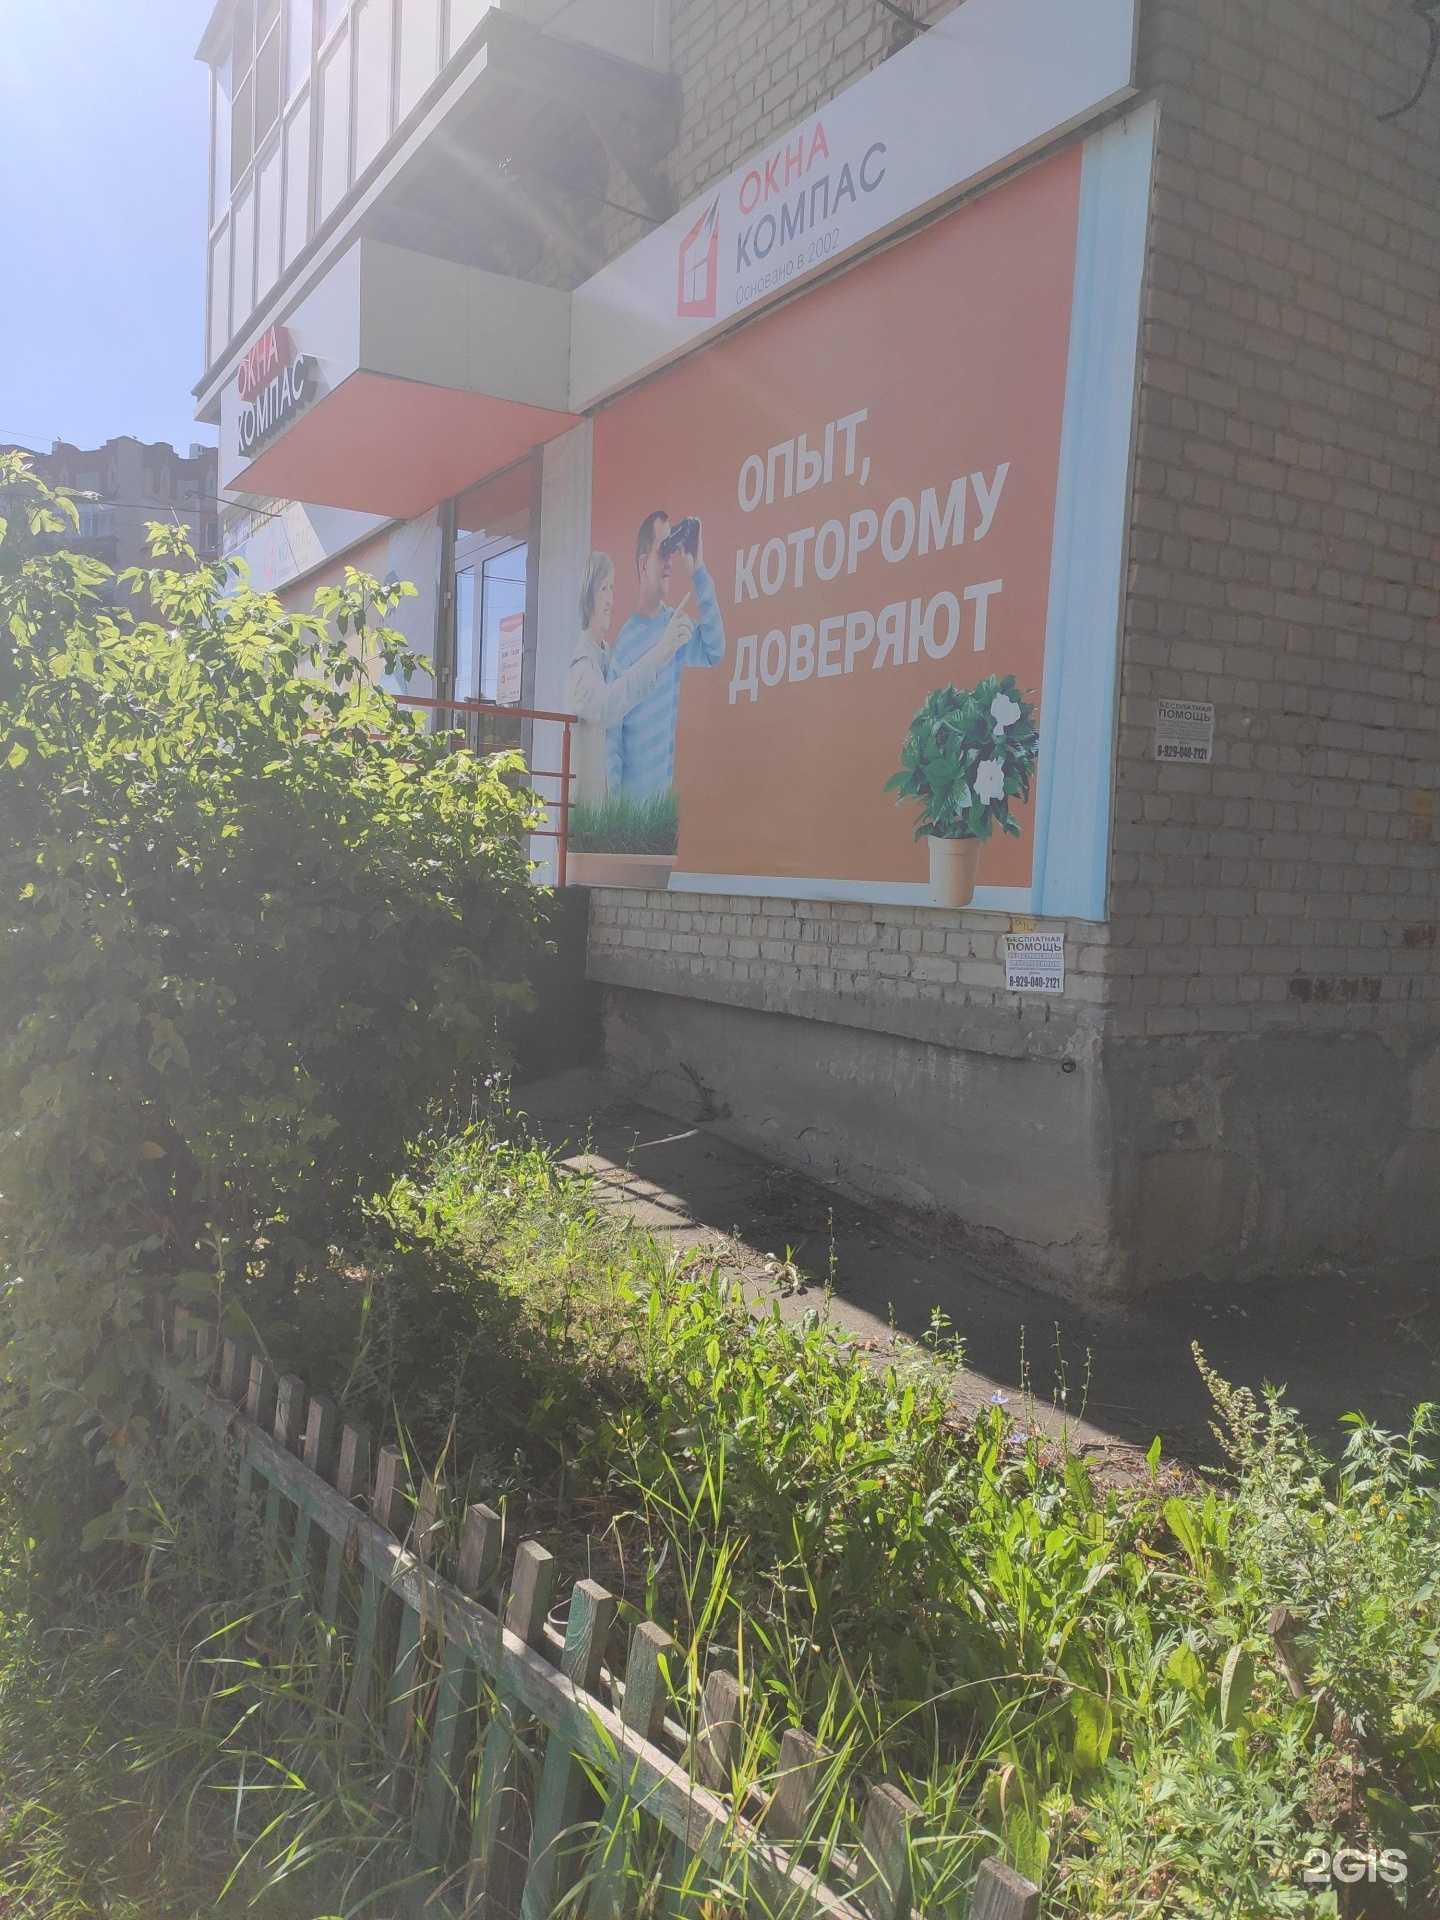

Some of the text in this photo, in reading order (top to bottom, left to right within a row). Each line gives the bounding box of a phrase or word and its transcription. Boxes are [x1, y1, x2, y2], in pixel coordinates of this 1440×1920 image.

[735, 142, 887, 273] КОМПАС
[738, 121, 829, 215] ОКНА
[808, 227, 840, 264] 2002
[237, 326, 280, 397] ОКНА
[238, 353, 305, 451] КОМПАС
[738, 408, 870, 512] ОПЫТ,
[735, 462, 1010, 603] КОТОРОМУ
[728, 579, 1003, 705] ДОВЕРЯЮТ
[1159, 708, 1211, 722] ПОМОЩЬ
[1008, 942, 1062, 952] ПОМОЩЬ
